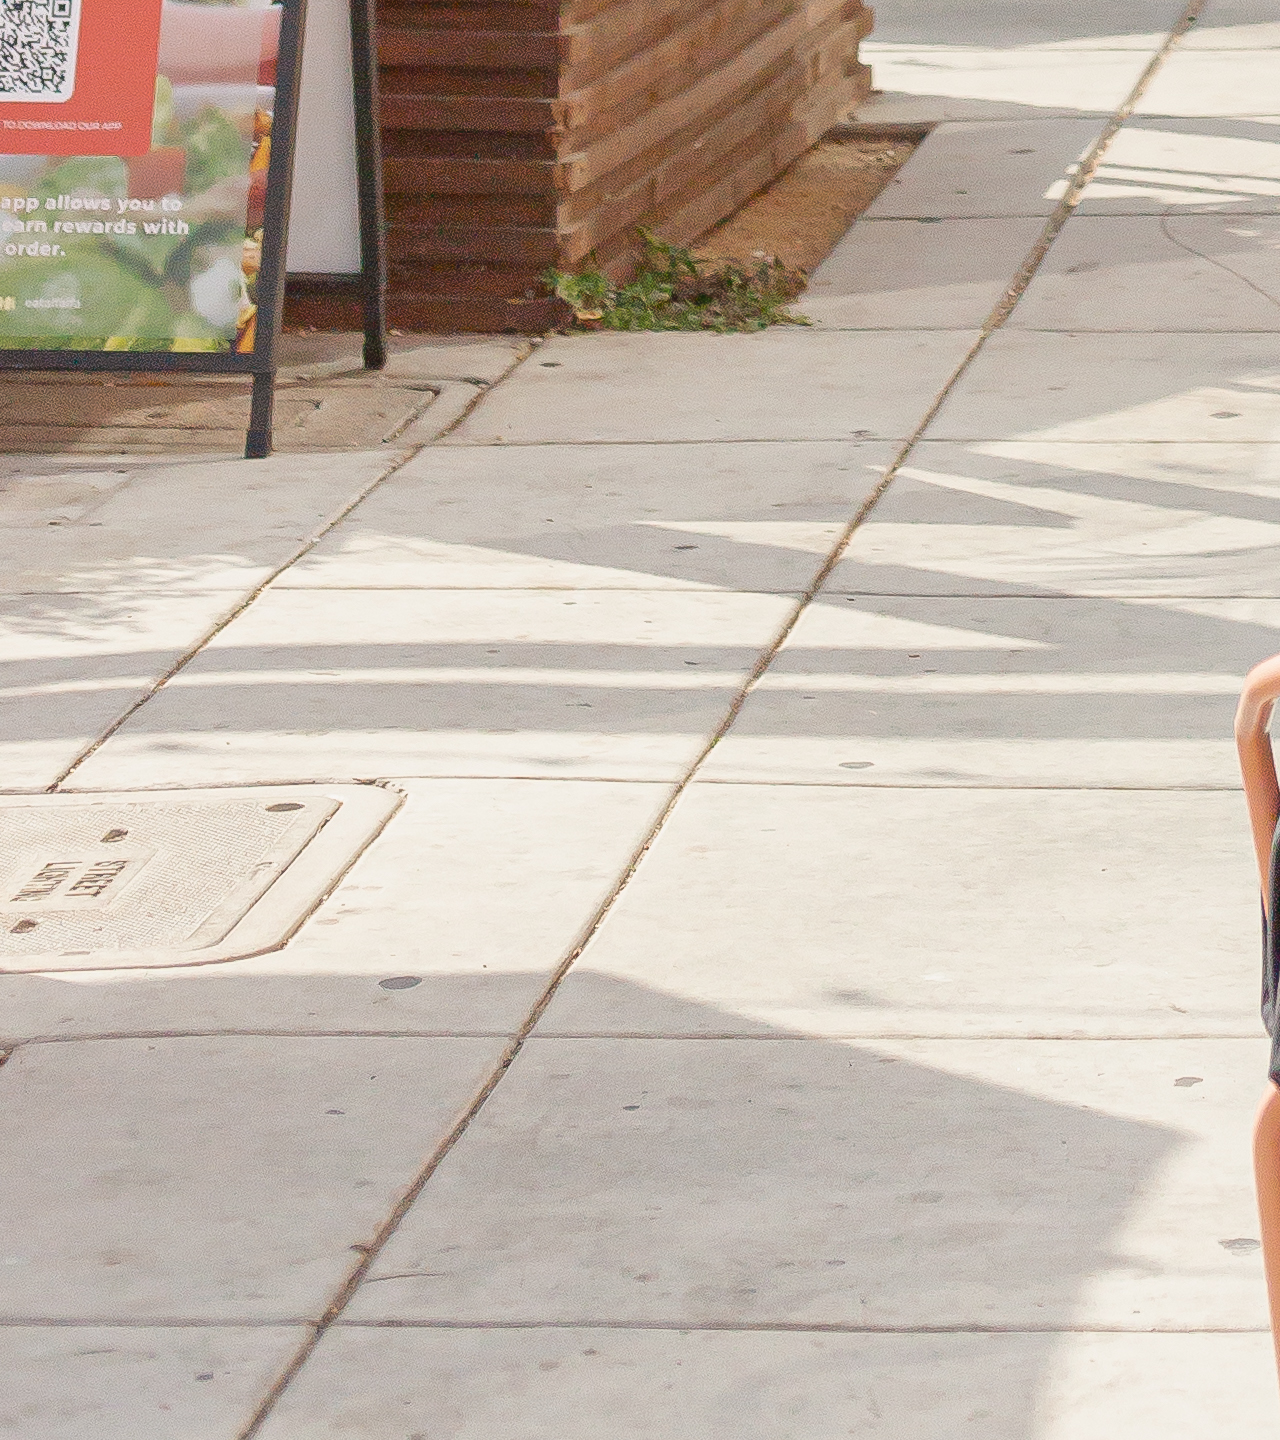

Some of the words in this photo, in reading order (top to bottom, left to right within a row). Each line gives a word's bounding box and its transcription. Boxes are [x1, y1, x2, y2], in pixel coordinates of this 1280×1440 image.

[1, 197, 40, 213] app
[44, 194, 112, 211] allows
[117, 197, 155, 214] you
[161, 196, 184, 212] to
[53, 219, 137, 235] rewards
[143, 219, 190, 235] with
[5, 241, 67, 257] order.
[9, 861, 83, 902] LIGHTING
[64, 860, 129, 897] STREET
